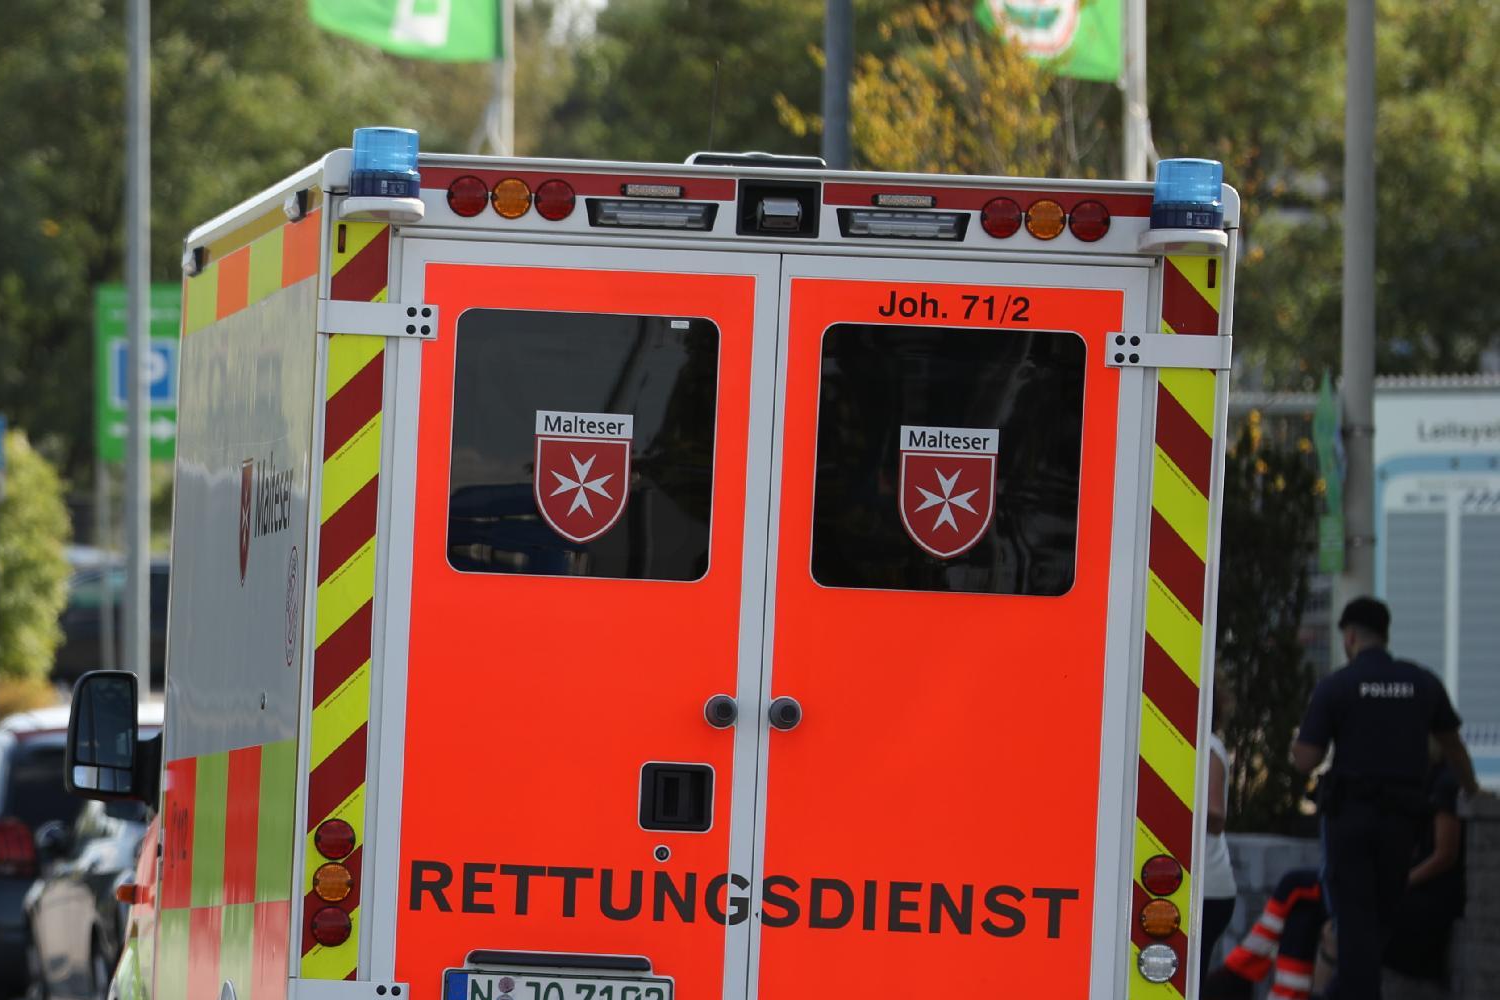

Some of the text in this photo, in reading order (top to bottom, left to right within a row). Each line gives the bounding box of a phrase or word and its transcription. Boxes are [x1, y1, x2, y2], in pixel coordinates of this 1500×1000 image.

[878, 290, 1031, 325] Joh. 71/2
[543, 415, 626, 437] Malteser
[908, 430, 990, 452] Malteser
[254, 450, 294, 538] Malteser
[1360, 682, 1414, 698] POLIZEI
[408, 859, 1080, 940] RETTUNGSDIENST
